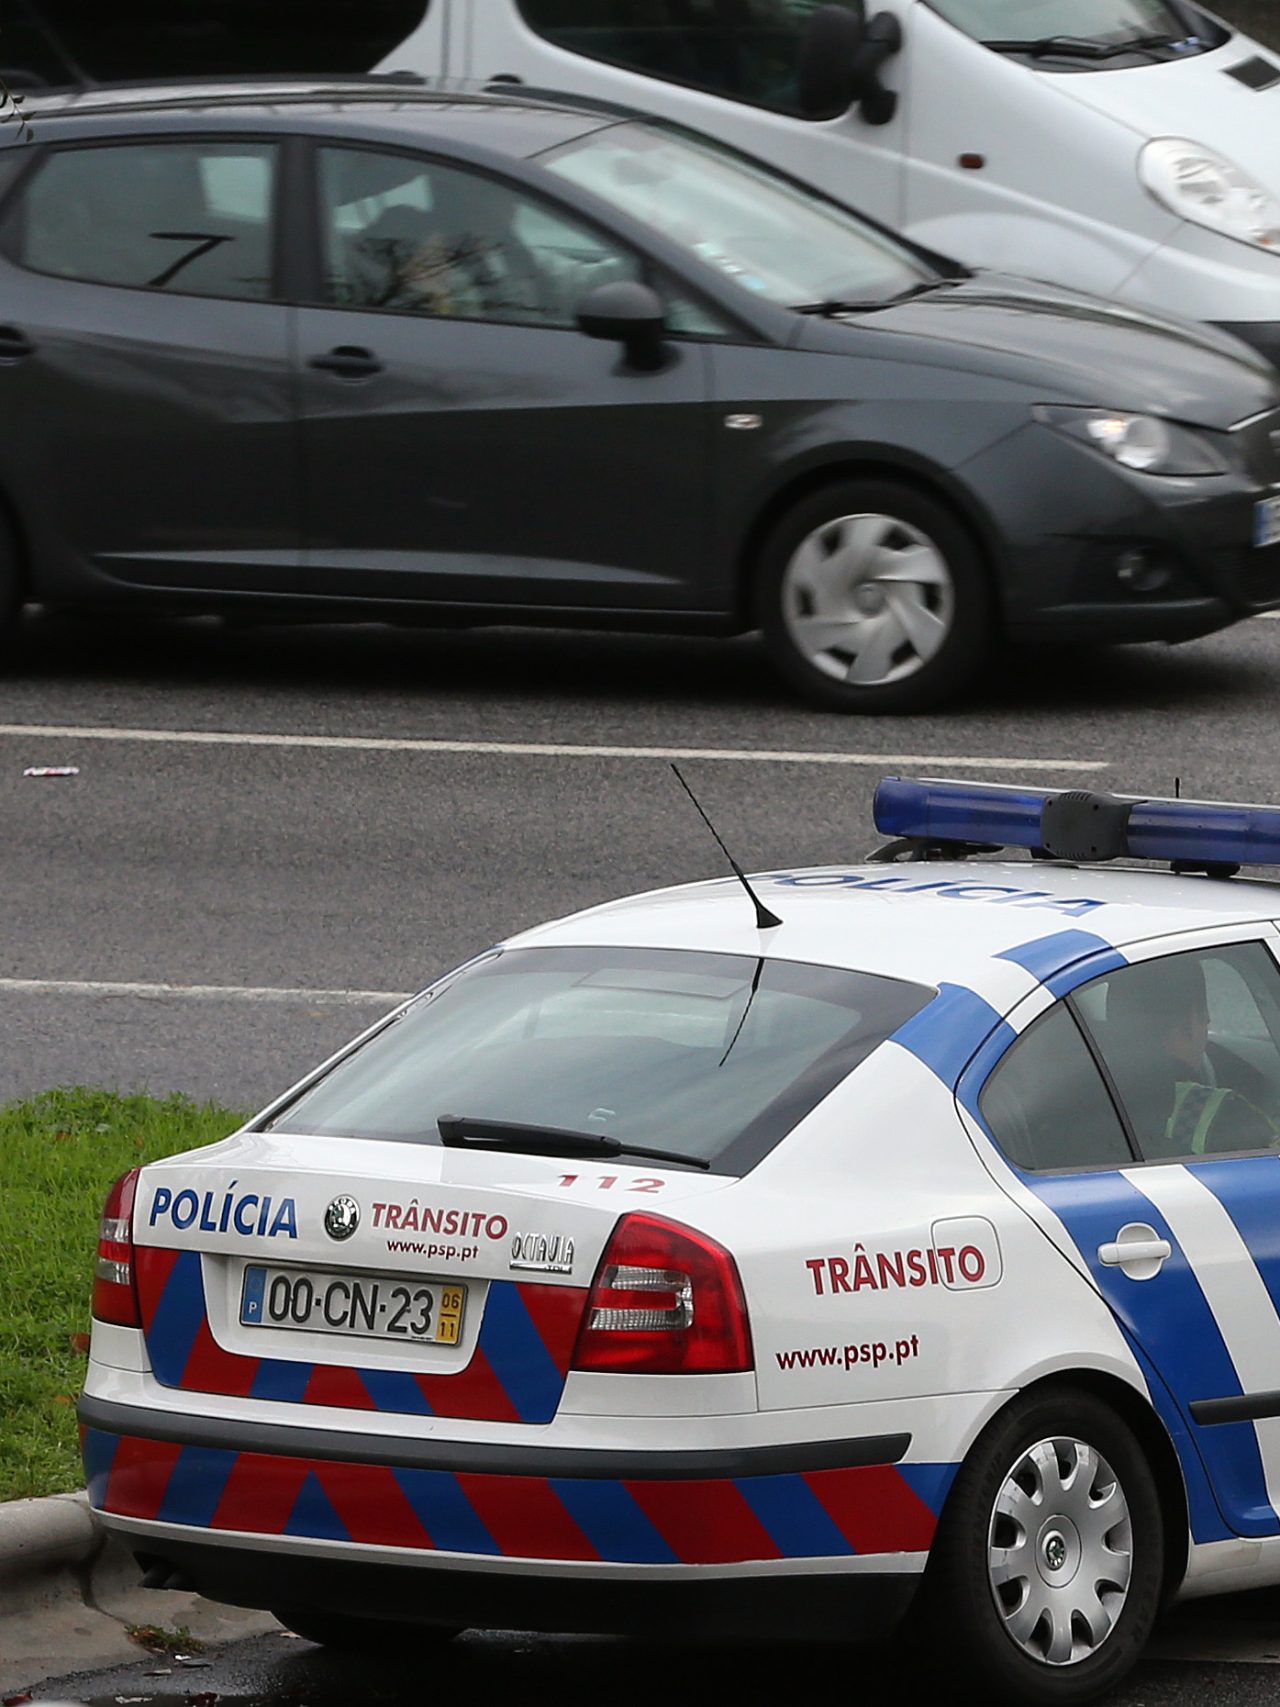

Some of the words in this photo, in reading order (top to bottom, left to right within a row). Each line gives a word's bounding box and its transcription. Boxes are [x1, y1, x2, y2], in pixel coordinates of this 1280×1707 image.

[556, 1174, 666, 1194] 112
[149, 1180, 298, 1239] POLÍCIA
[372, 1199, 508, 1240] TRÂNSITO
[387, 1240, 479, 1262] www.psp.pt
[806, 1243, 985, 1295] TRÂNSITO
[249, 1302, 257, 1314] P
[442, 1292, 460, 1309] 06
[441, 1321, 456, 1338] 11
[776, 1334, 919, 1371] www.psp.pt
